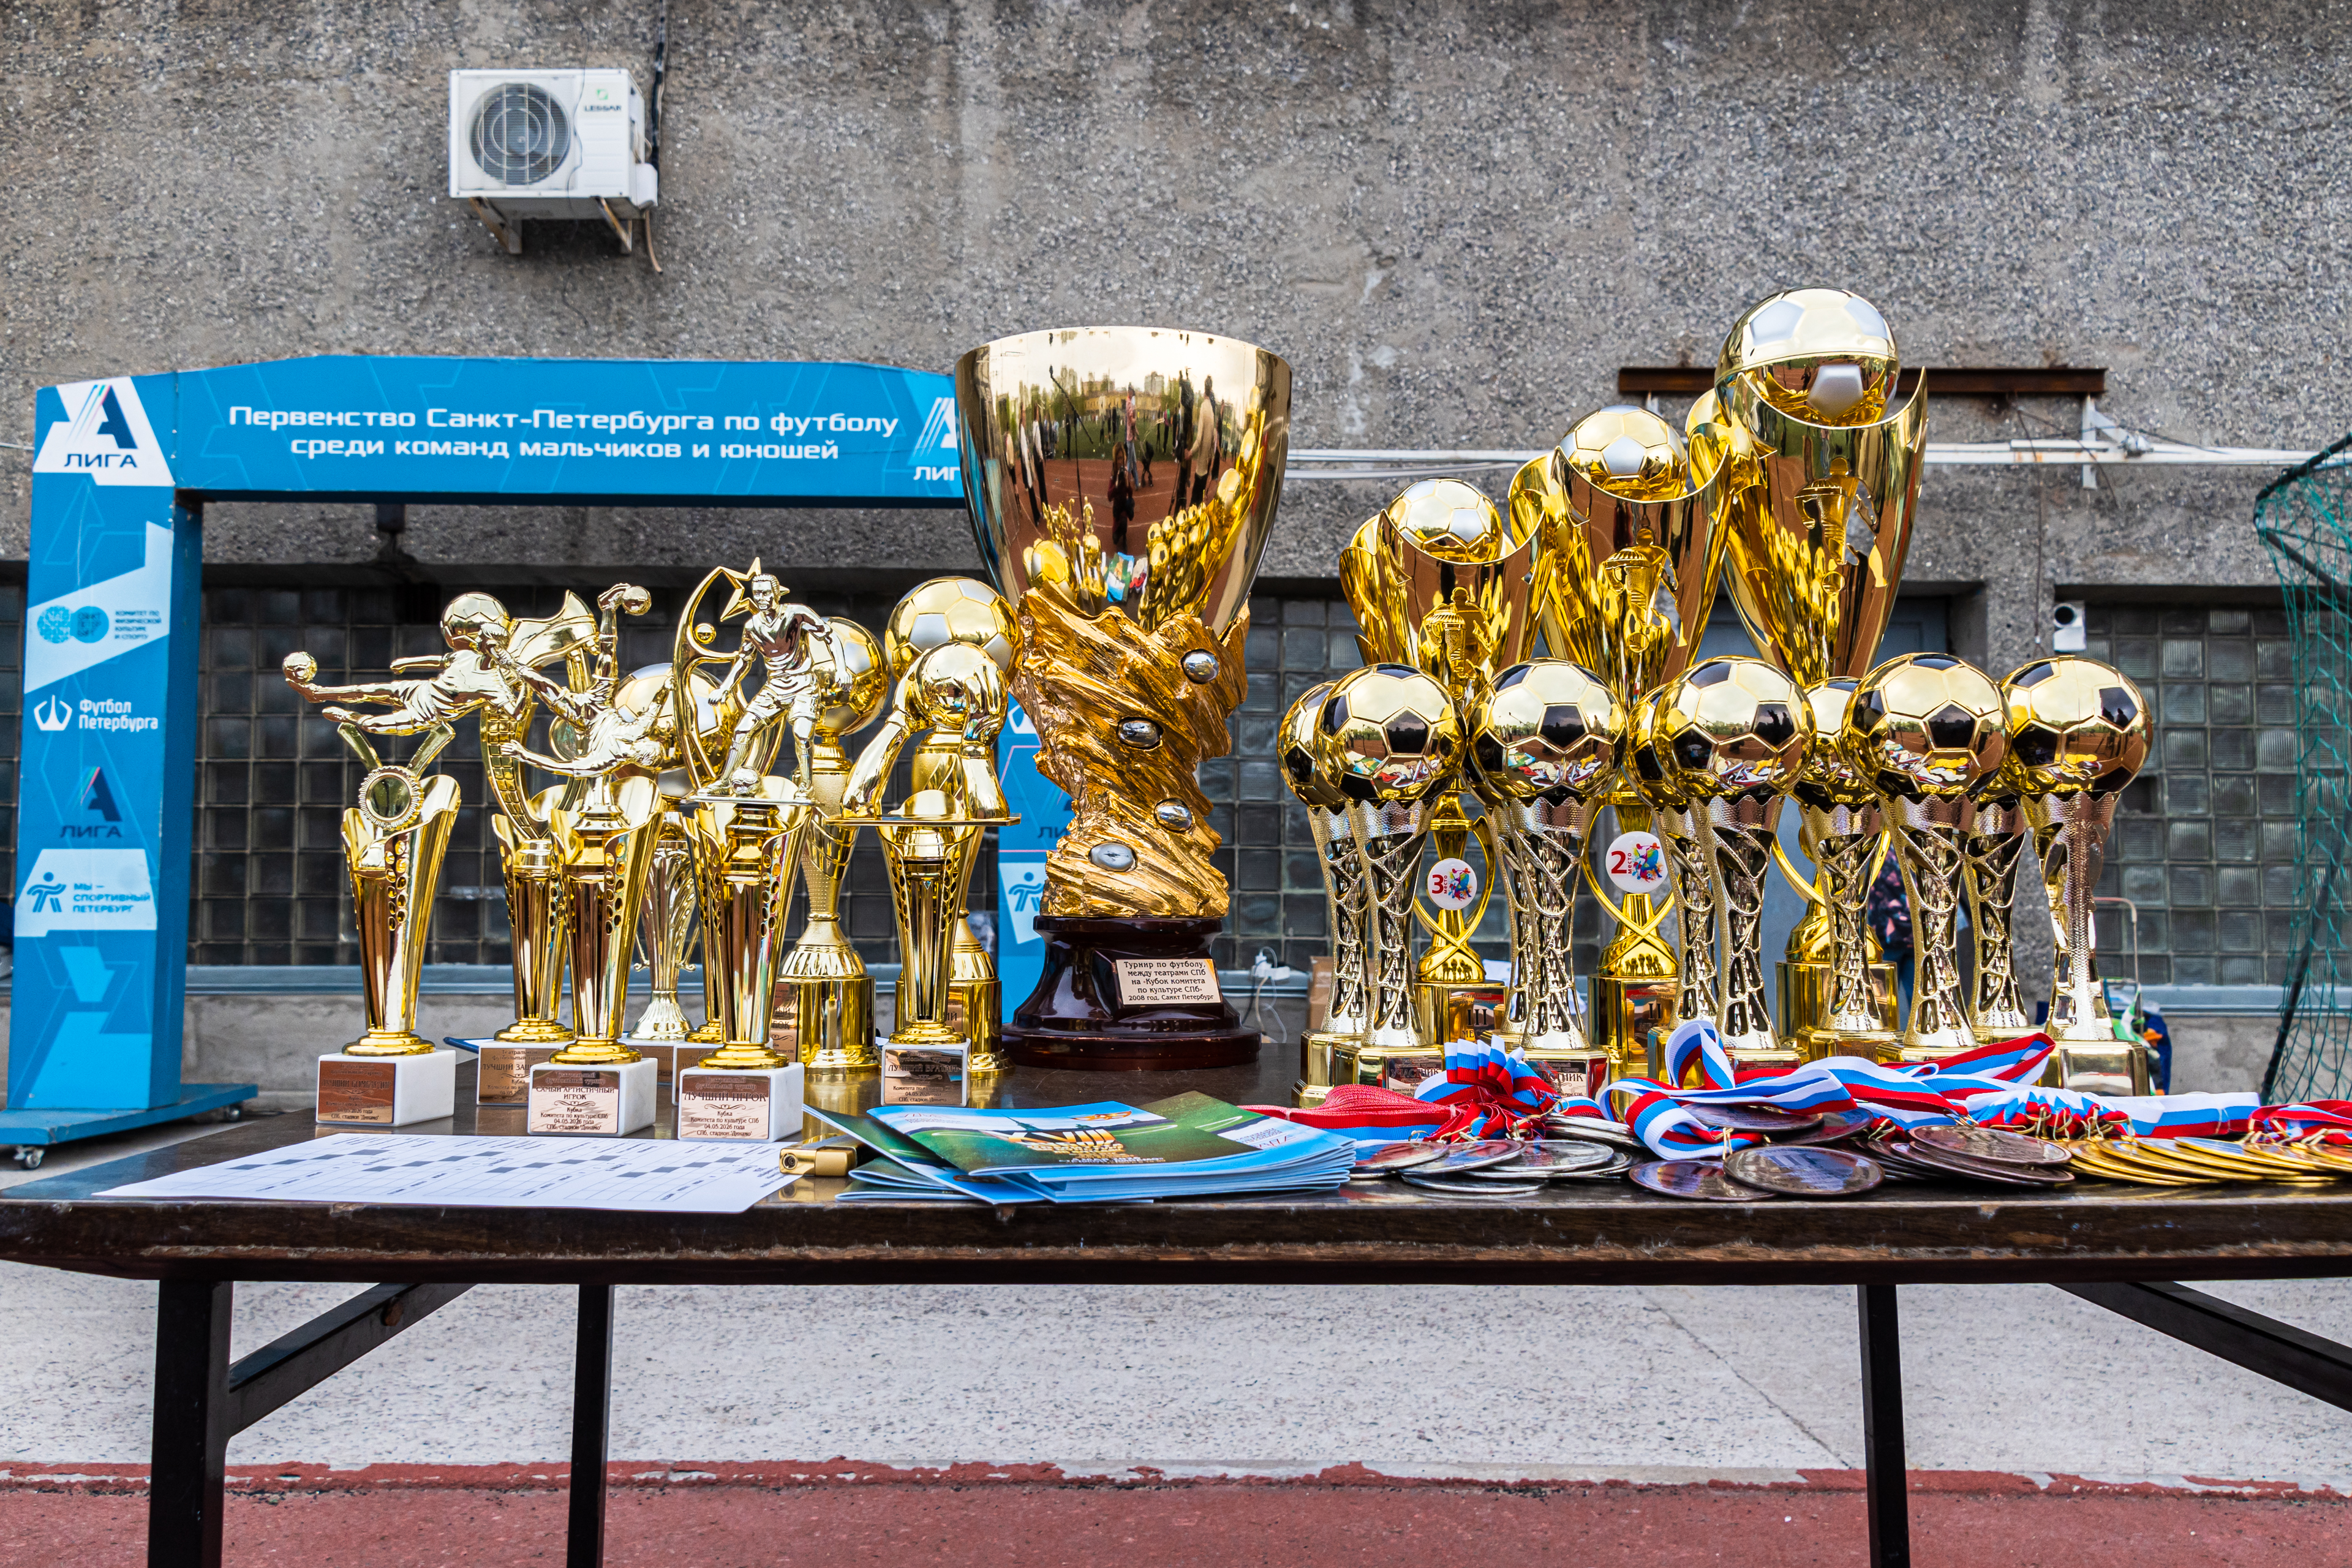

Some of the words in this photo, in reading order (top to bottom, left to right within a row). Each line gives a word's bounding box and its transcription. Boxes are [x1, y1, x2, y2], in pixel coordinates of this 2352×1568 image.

[229, 405, 416, 431] Первенство
[427, 408, 714, 435] Санкт-Петербурга
[725, 416, 760, 431] по
[771, 412, 899, 438] футболу
[290, 439, 385, 459] среди
[395, 439, 510, 459] команд
[519, 440, 682, 459] мальчиков
[692, 443, 710, 458] и
[720, 440, 839, 459] юношей
[64, 453, 138, 468] ЛИГА
[913, 466, 960, 481] ЛИГ
[79, 698, 132, 717] Футбол
[78, 714, 159, 733] Петербурга
[60, 825, 123, 839] ЛИГА
[1611, 850, 1627, 874] 2
[1431, 874, 1444, 894] 3
[73, 892, 151, 902] СПОРТИВНЫЙ
[72, 905, 134, 913] ПЕТЕРБУРГ
[1169, 960, 1206, 969] футболу,
[1154, 970, 1189, 978] театрами
[1466, 1008, 1489, 1027] III
[1648, 1003, 1662, 1020] II
[888, 1063, 924, 1072] ЛУЧШИЙ
[1390, 1068, 1439, 1078] УЧАСТНИК
[684, 1091, 729, 1101] ЛУЧШИЙ
[732, 1093, 766, 1102] ИГРОК
